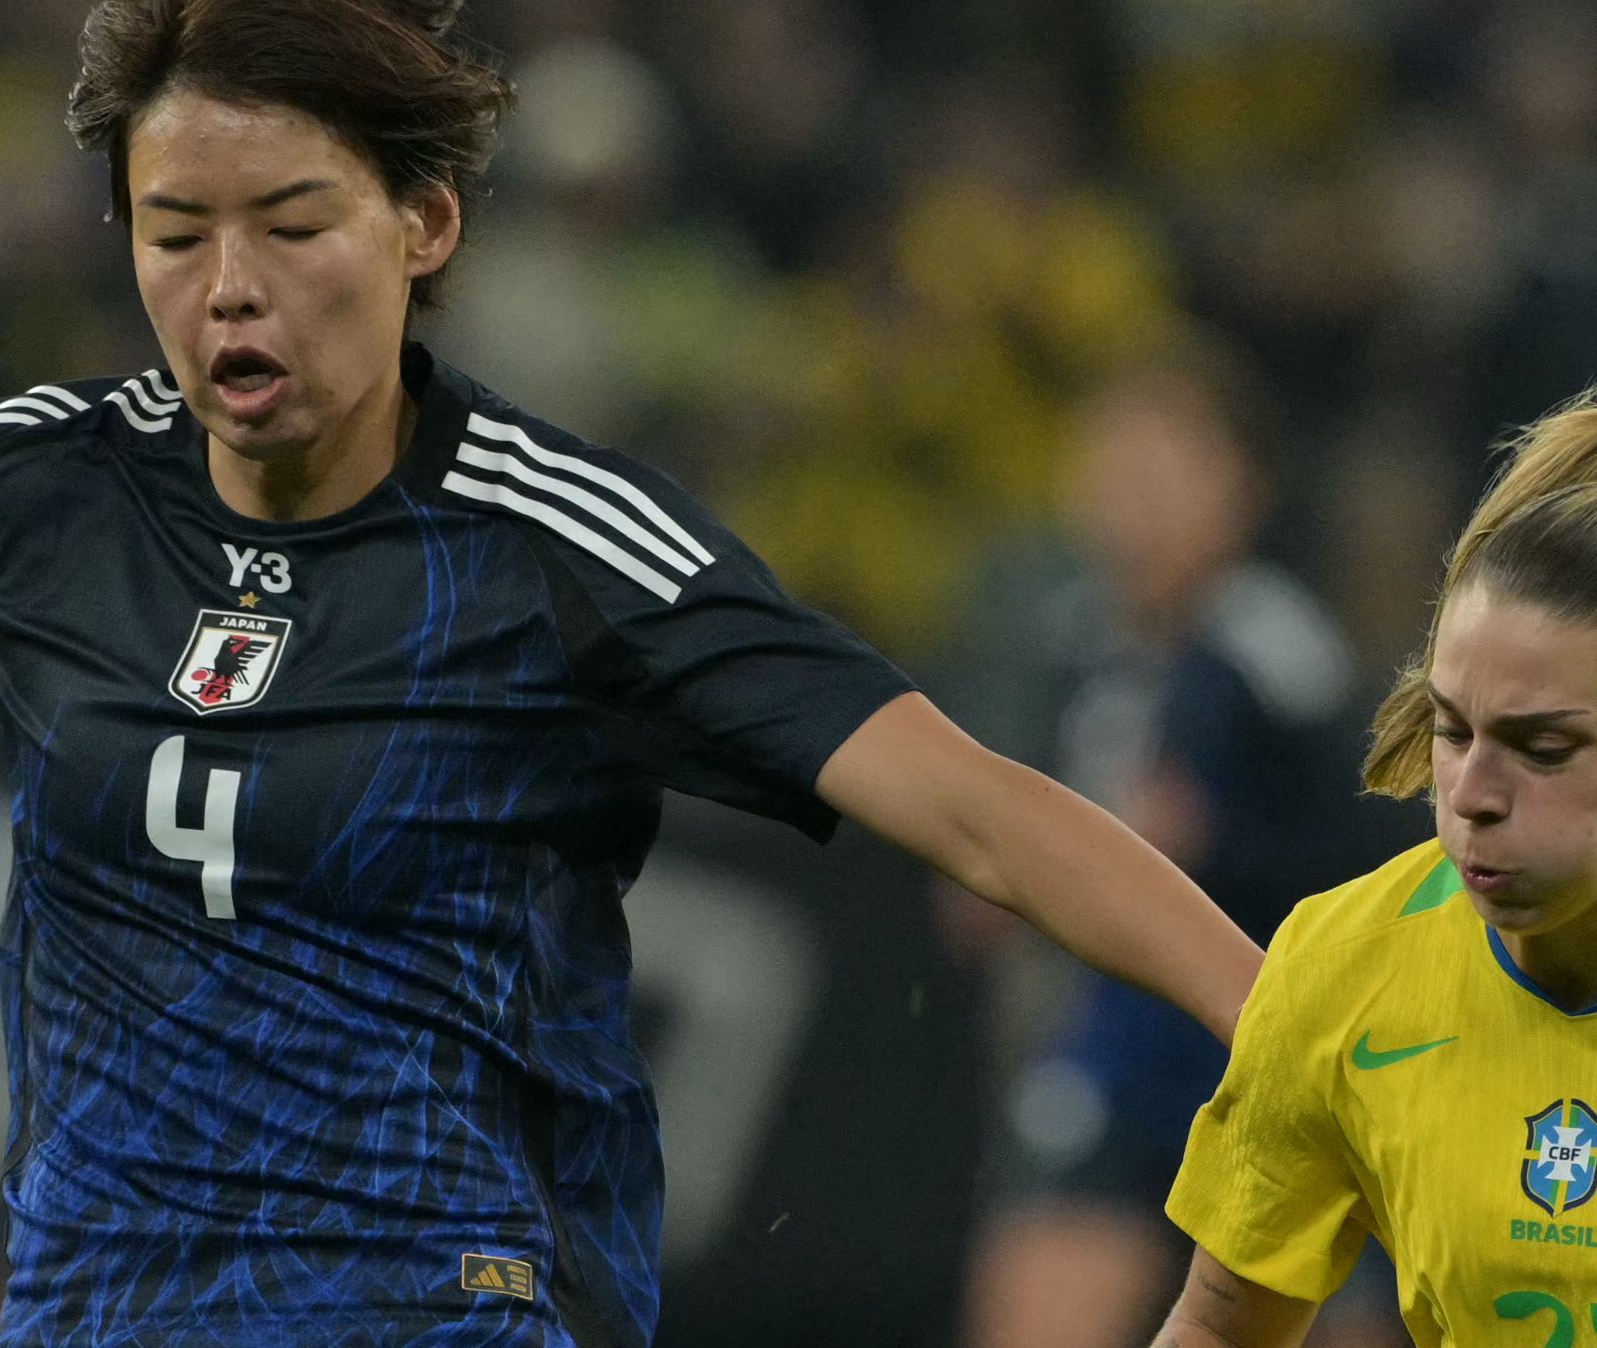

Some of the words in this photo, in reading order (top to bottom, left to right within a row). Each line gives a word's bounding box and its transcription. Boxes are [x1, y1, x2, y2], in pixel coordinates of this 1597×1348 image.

[221, 543, 292, 594] Y-3
[219, 617, 267, 631] JAPAN
[145, 734, 242, 920] 4
[1548, 1146, 1581, 1161] CBF
